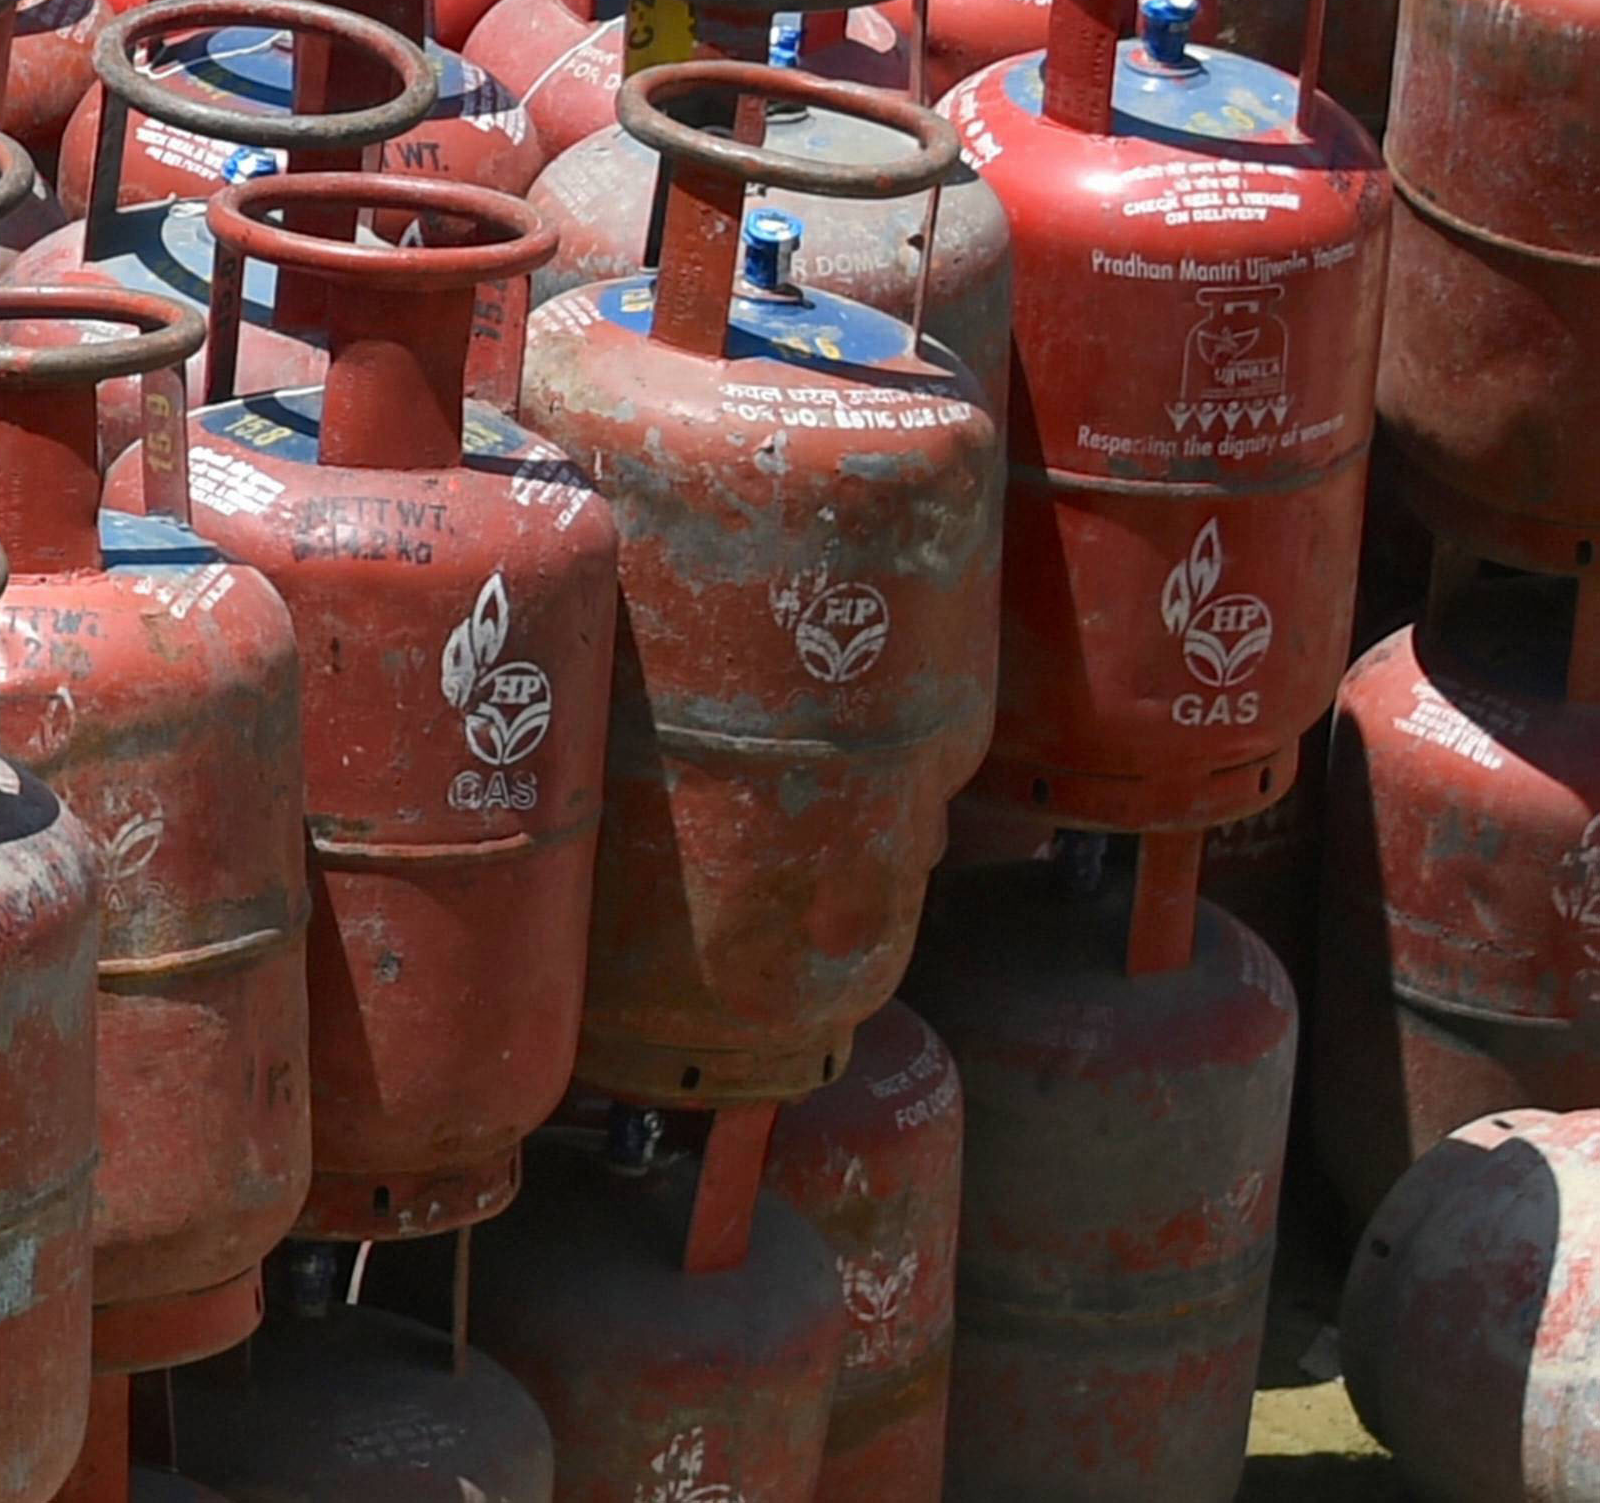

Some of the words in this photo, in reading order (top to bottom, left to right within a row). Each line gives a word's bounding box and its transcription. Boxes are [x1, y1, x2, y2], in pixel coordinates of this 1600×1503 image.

[1091, 248, 1174, 280] Pradhan
[1180, 258, 1240, 282] Mantri
[223, 412, 293, 448] 15.8
[1077, 423, 1177, 457] Respecing
[1183, 437, 1213, 455] the
[1217, 436, 1277, 461] dignity
[823, 596, 878, 626] HP
[1210, 604, 1259, 633] HP
[488, 675, 541, 705] HP
[1173, 692, 1261, 726] GAS
[448, 769, 538, 810] GAS
